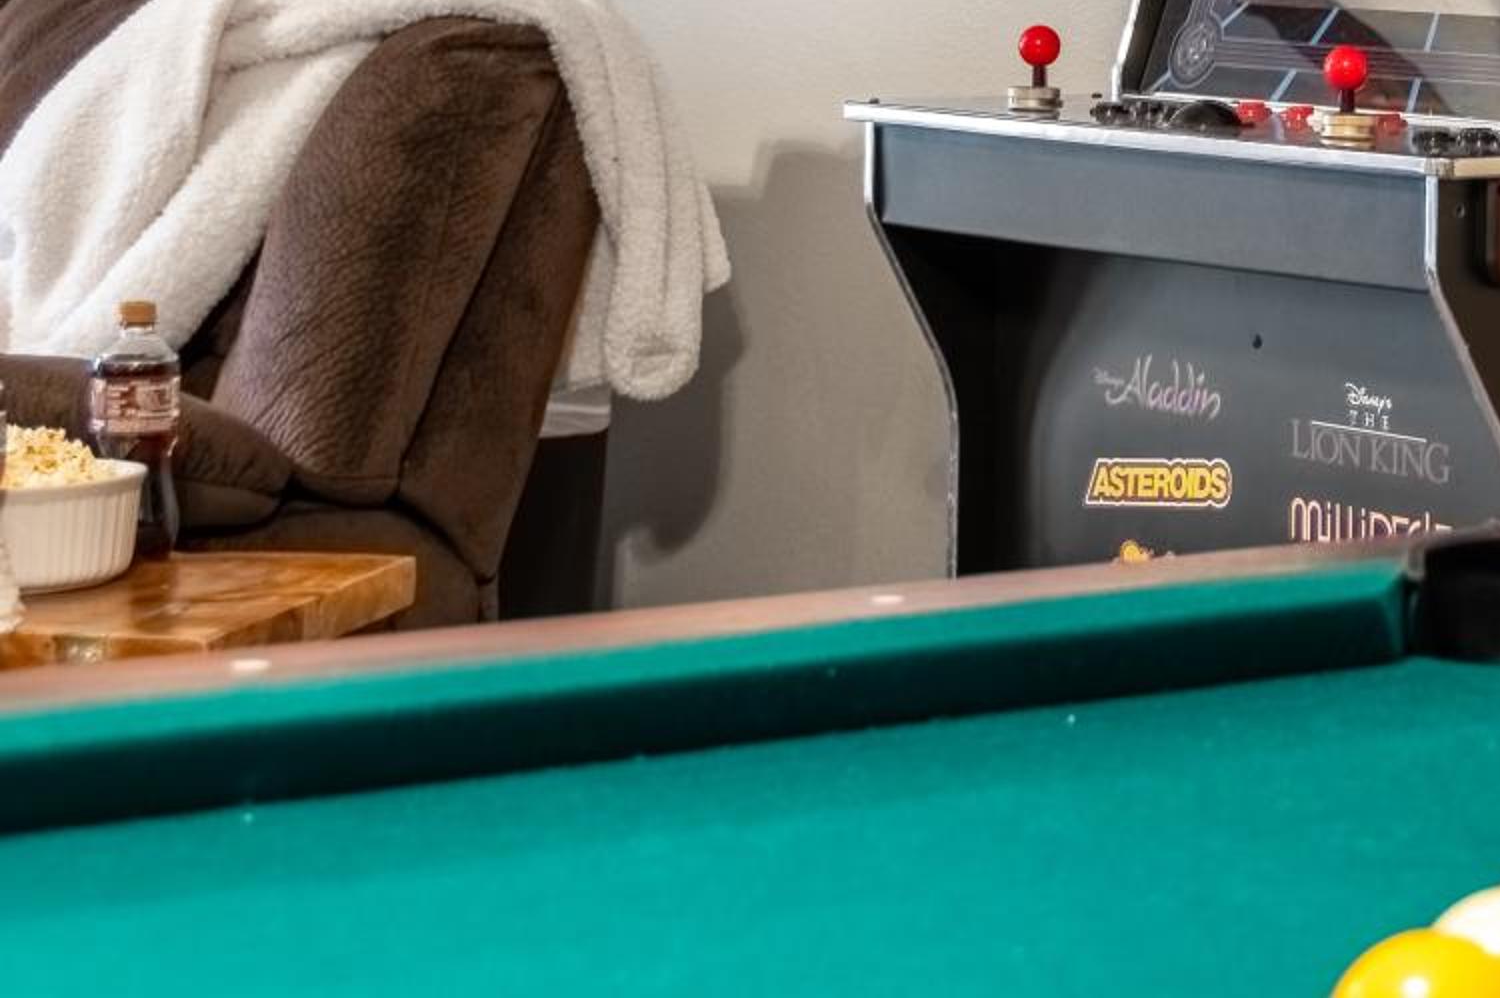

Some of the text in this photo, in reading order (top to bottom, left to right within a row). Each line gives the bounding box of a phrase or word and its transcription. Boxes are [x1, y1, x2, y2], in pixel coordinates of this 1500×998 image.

[1105, 353, 1221, 420] Aladdin
[1092, 466, 1228, 499] ASTEROIDS
[1291, 419, 1452, 484] LION KING
